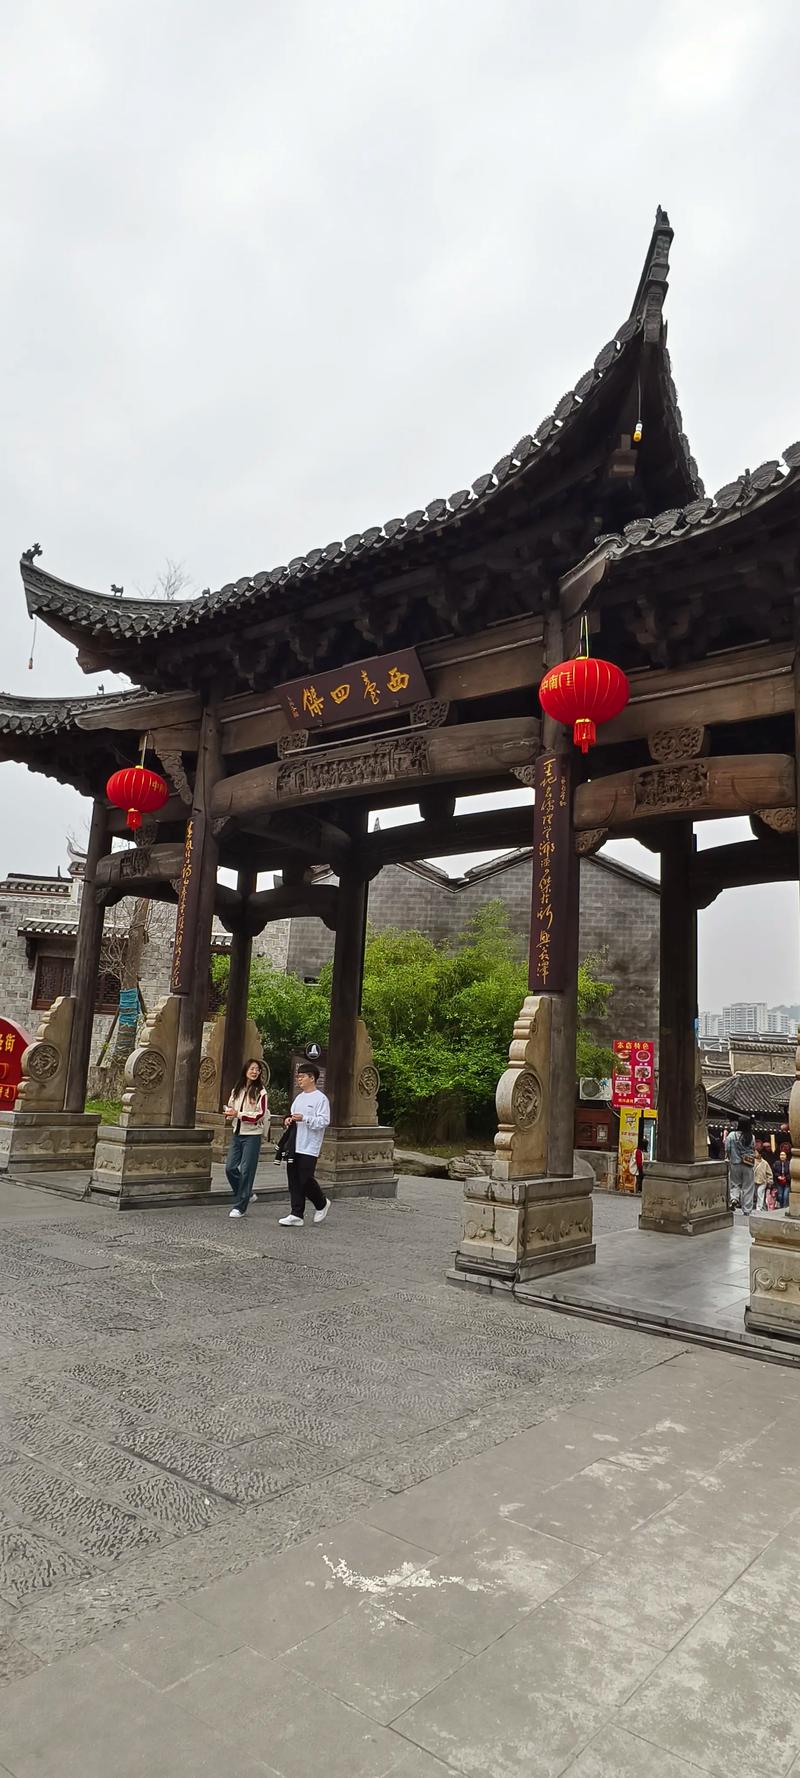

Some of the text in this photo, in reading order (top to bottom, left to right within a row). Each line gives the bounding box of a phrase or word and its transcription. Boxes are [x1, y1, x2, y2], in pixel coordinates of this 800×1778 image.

[540, 671, 573, 695] 中南门
[617, 1041, 649, 1051] 本店特色
